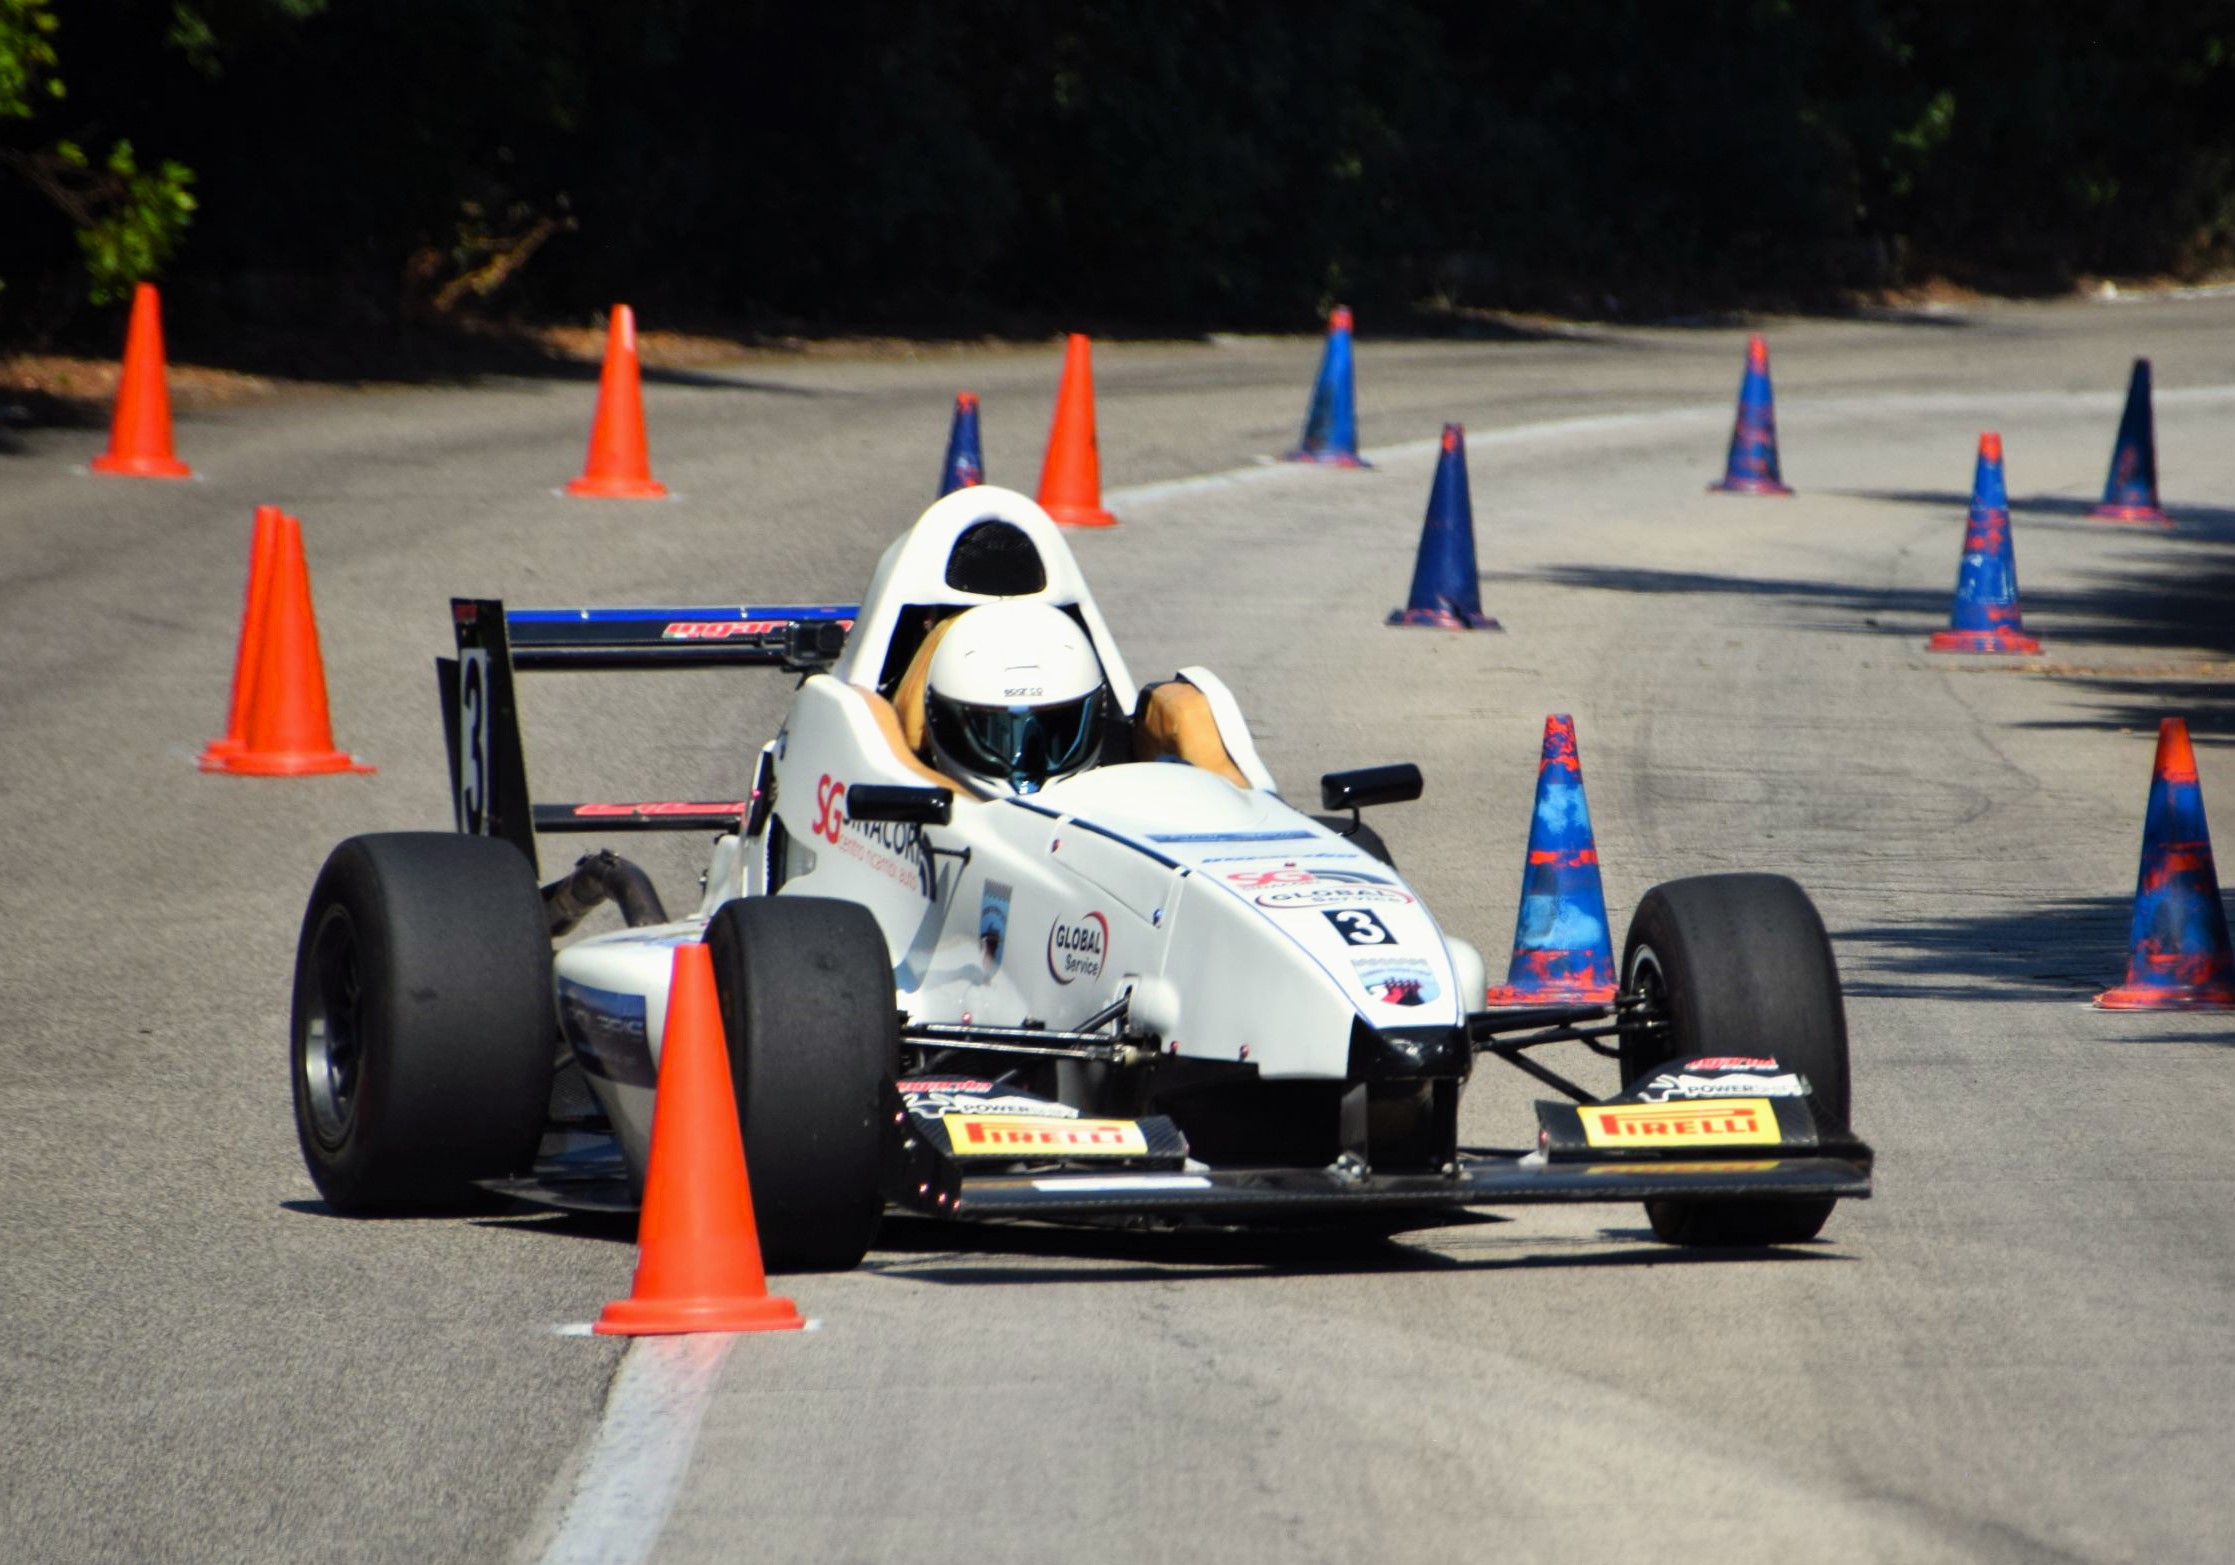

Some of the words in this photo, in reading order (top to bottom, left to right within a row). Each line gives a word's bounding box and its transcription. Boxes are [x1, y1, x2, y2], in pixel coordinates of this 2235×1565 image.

[463, 656, 483, 835] 3
[812, 773, 846, 844] SG
[1271, 889, 1396, 902] GLOBAL
[1056, 924, 1101, 954] GLOBAL
[1335, 909, 1387, 945] 3
[1064, 953, 1099, 977] Service
[964, 1121, 1125, 1144] PIRELLI
[1599, 1108, 1759, 1136] PIRELLI
